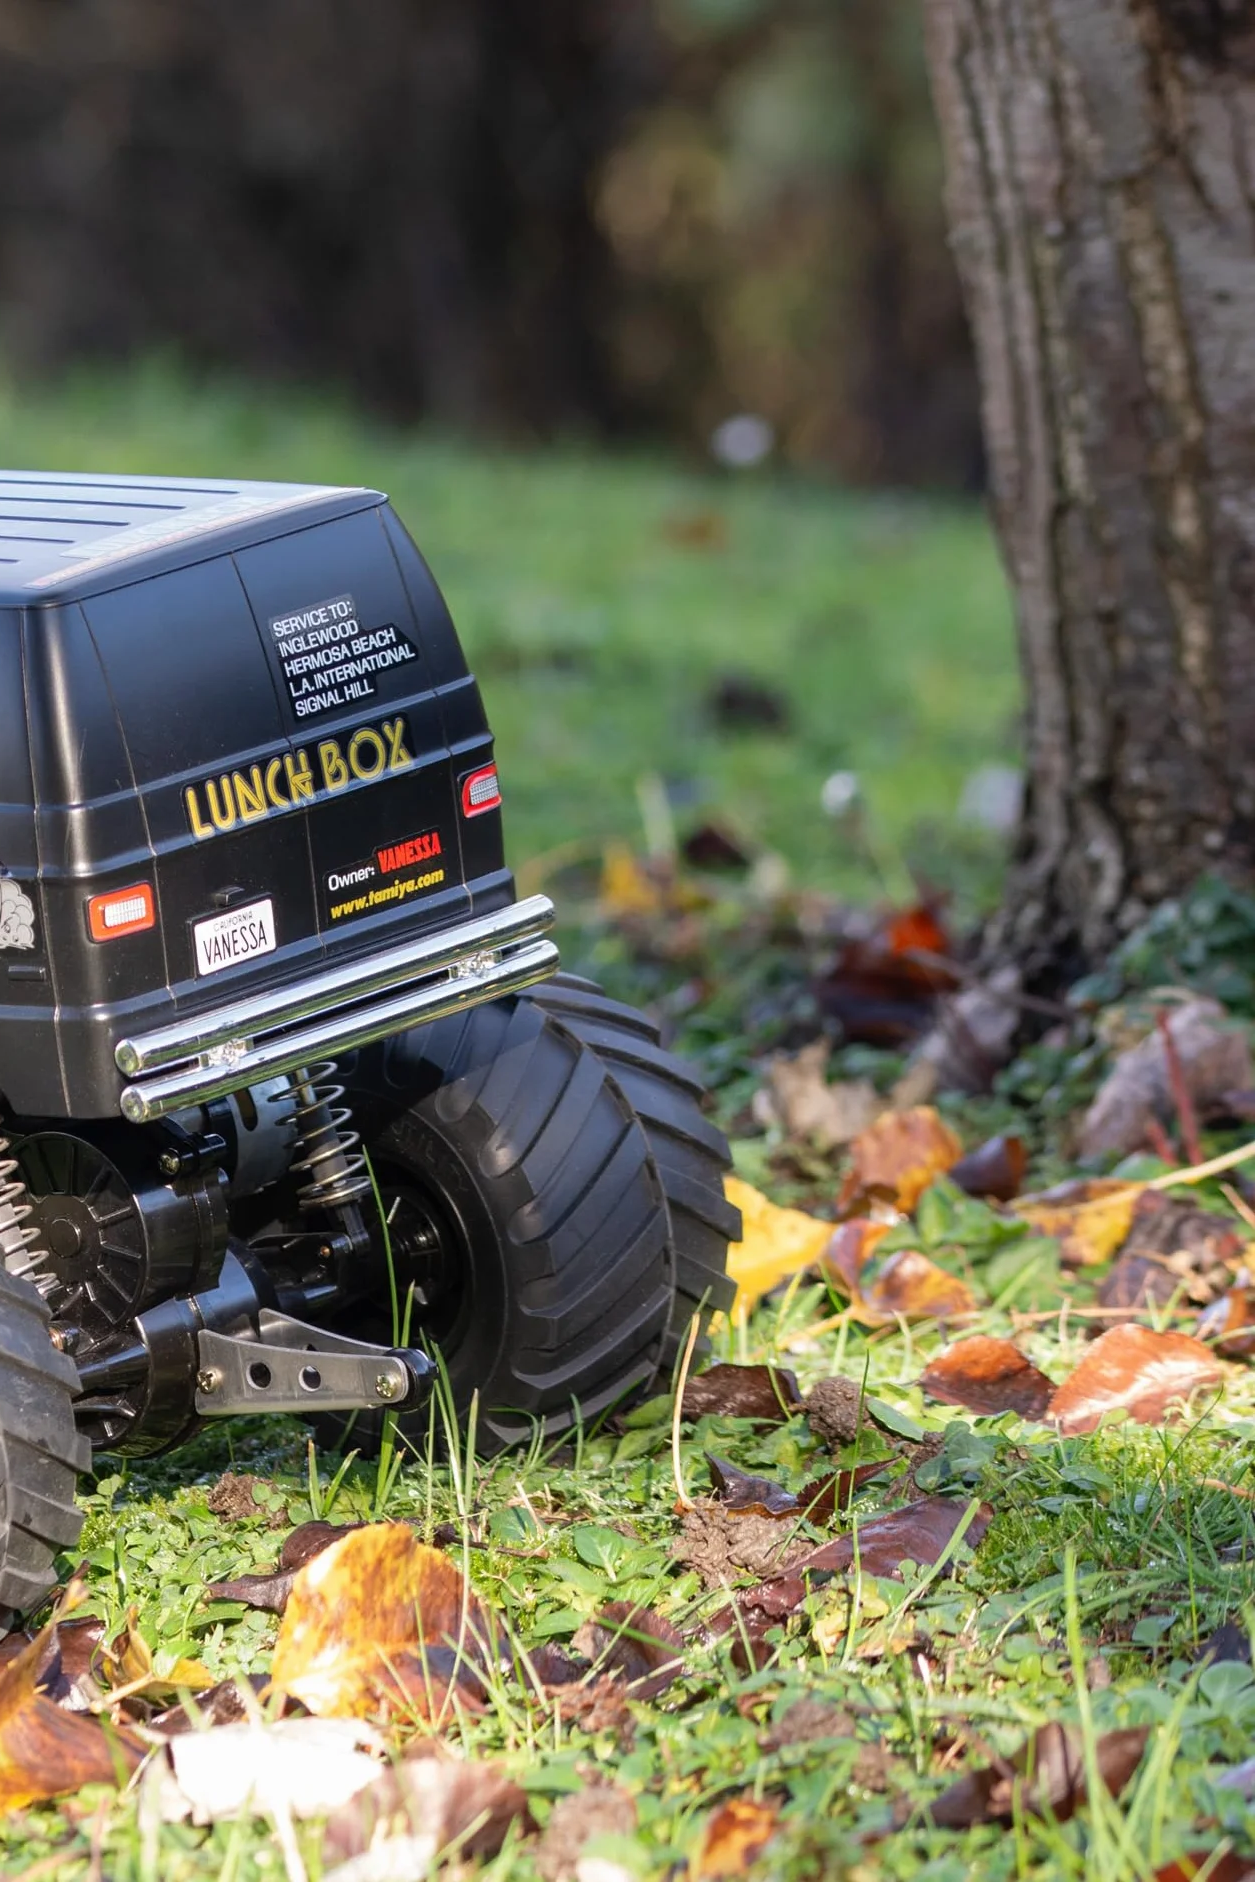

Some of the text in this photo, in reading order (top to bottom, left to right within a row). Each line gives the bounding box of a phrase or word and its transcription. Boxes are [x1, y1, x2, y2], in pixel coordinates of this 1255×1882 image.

[273, 601, 353, 638] SERVICE TO:
[278, 620, 359, 657] INGLEWOOD
[284, 627, 397, 677] HERMOSA BEACH
[289, 644, 416, 698] L.A. INTERNATIONAL
[295, 679, 375, 717] SIGNAL HILL
[184, 717, 414, 838] LUNCH BOX
[328, 832, 442, 892] Owner: VANESSA
[330, 869, 445, 920] www.tamiya.com
[203, 919, 268, 966] VANESSA
[213, 910, 254, 933] CALIFORNIA
